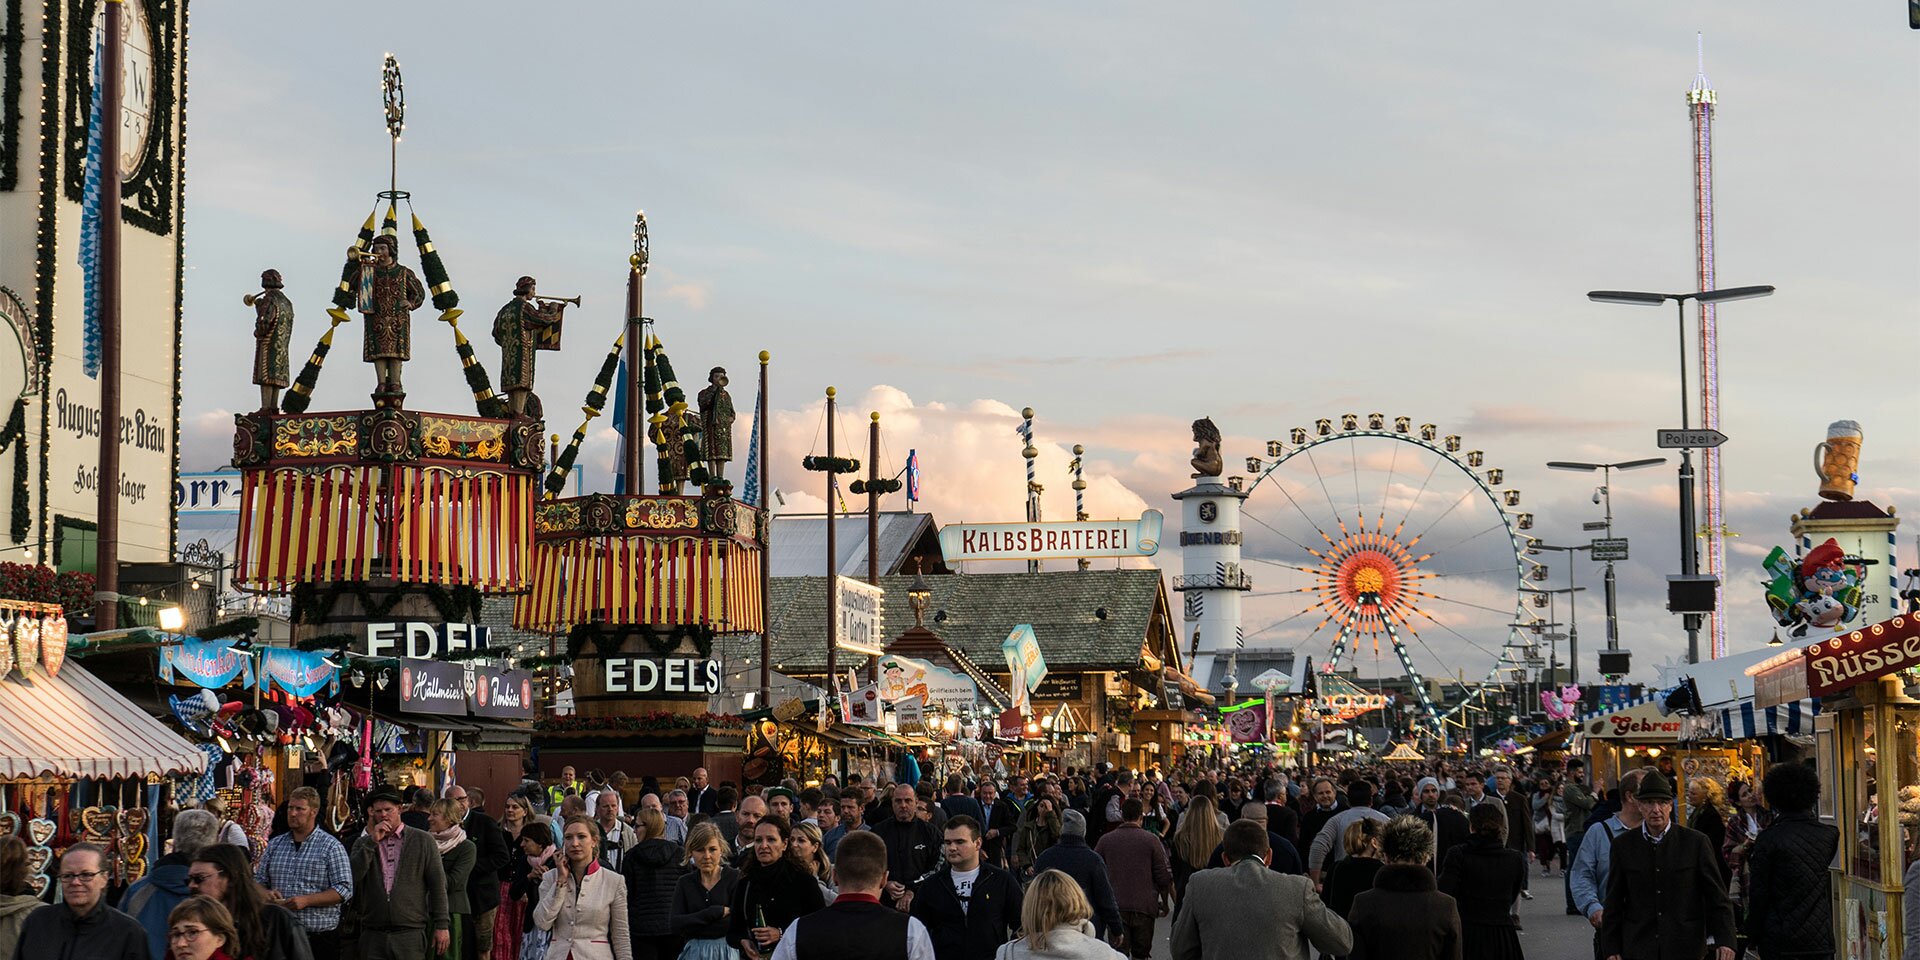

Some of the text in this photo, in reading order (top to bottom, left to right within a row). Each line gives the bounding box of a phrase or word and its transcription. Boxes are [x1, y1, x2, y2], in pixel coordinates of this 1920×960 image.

[1665, 433, 1710, 444] Polizei
[1811, 635, 1920, 688] Nüsse
[412, 670, 464, 701] Hällmeier's
[490, 676, 520, 708] Imbiss
